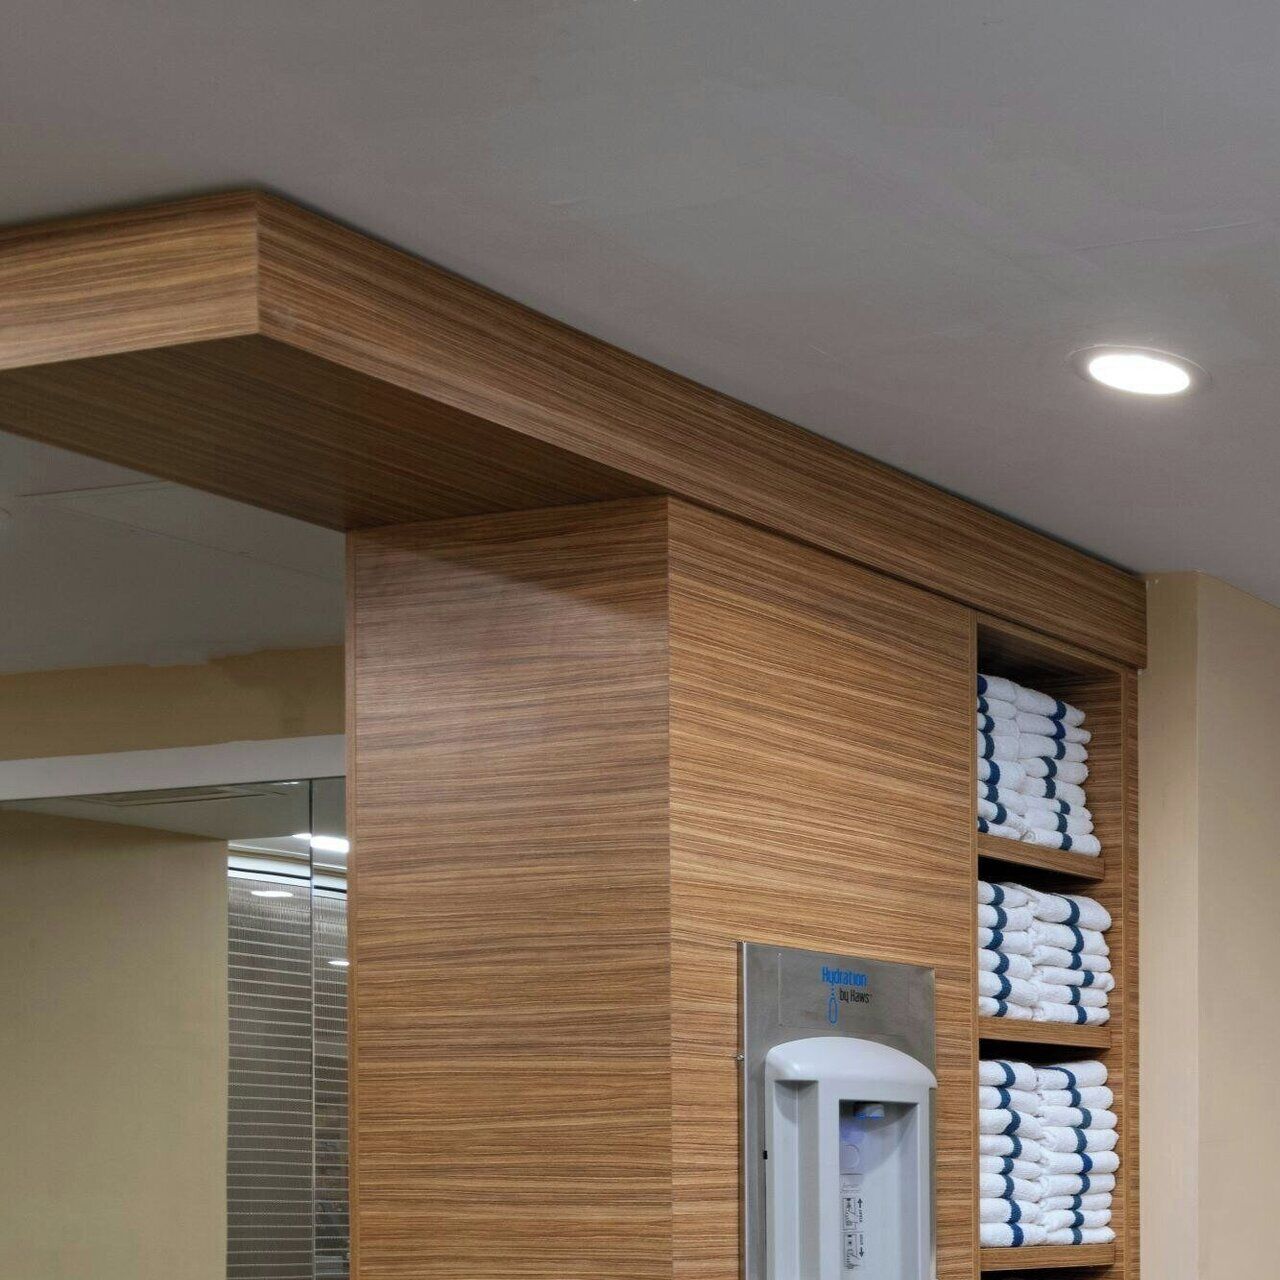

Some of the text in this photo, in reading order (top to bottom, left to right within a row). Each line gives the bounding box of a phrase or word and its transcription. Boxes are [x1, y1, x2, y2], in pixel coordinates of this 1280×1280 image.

[822, 966, 868, 987] Hydration
[840, 988, 870, 1004] by Haws
